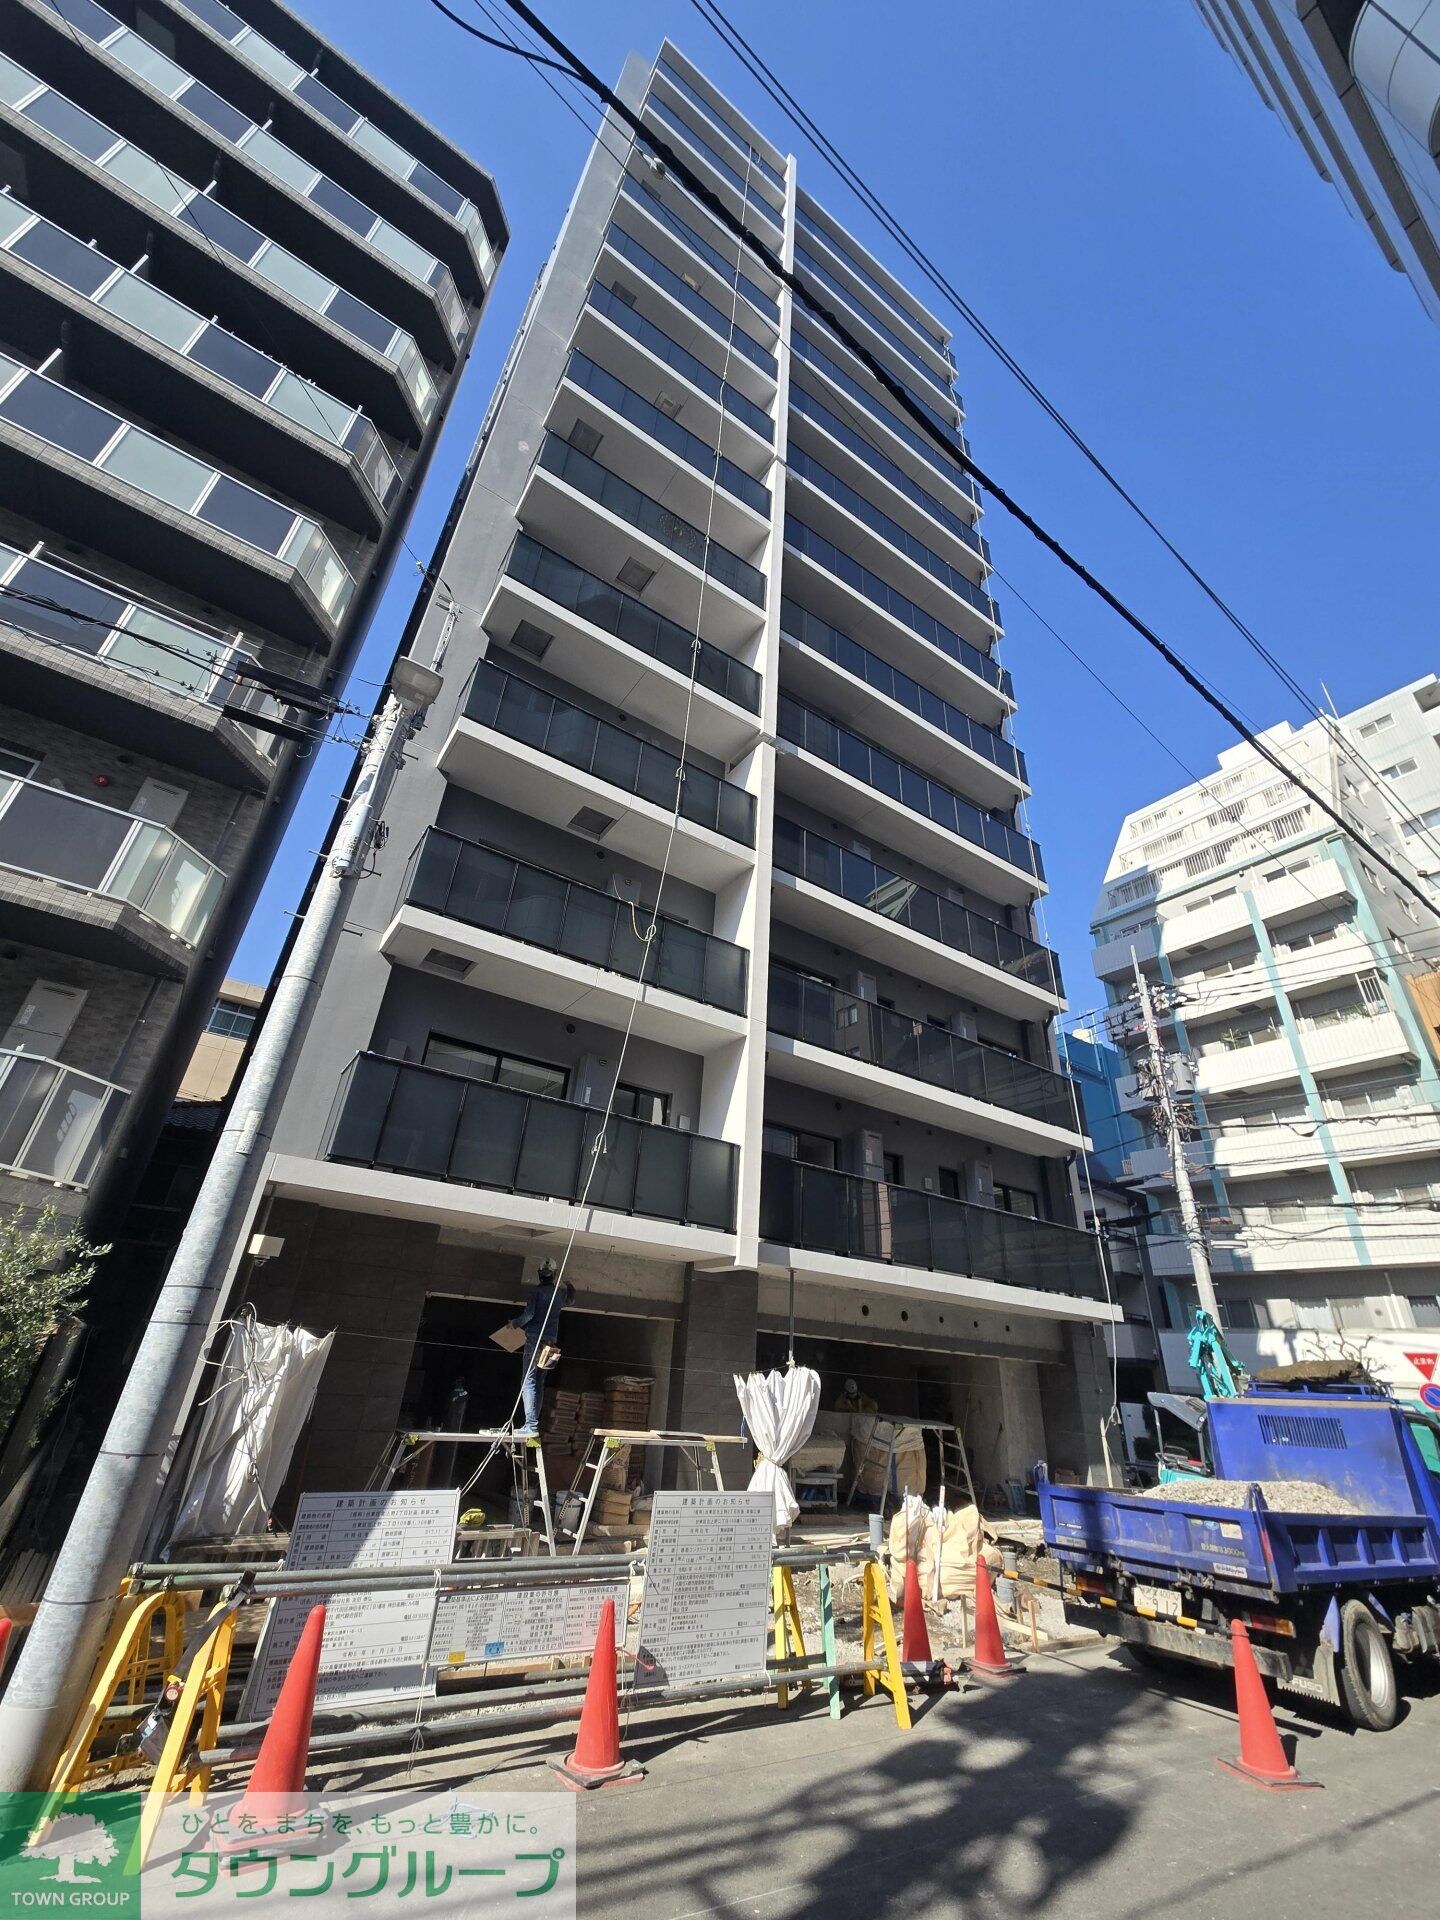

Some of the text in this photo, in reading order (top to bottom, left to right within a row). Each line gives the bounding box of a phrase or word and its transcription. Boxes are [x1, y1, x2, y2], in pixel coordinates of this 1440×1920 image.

[1413, 1357, 1435, 1365] 止まれ
[336, 1498, 427, 1508] 建築計画のお知らせ
[682, 1497, 751, 1506] 建築計画のお知らせ
[516, 1590, 559, 1598] 建設業の許可票
[1291, 1677, 1324, 1693] FUSO
